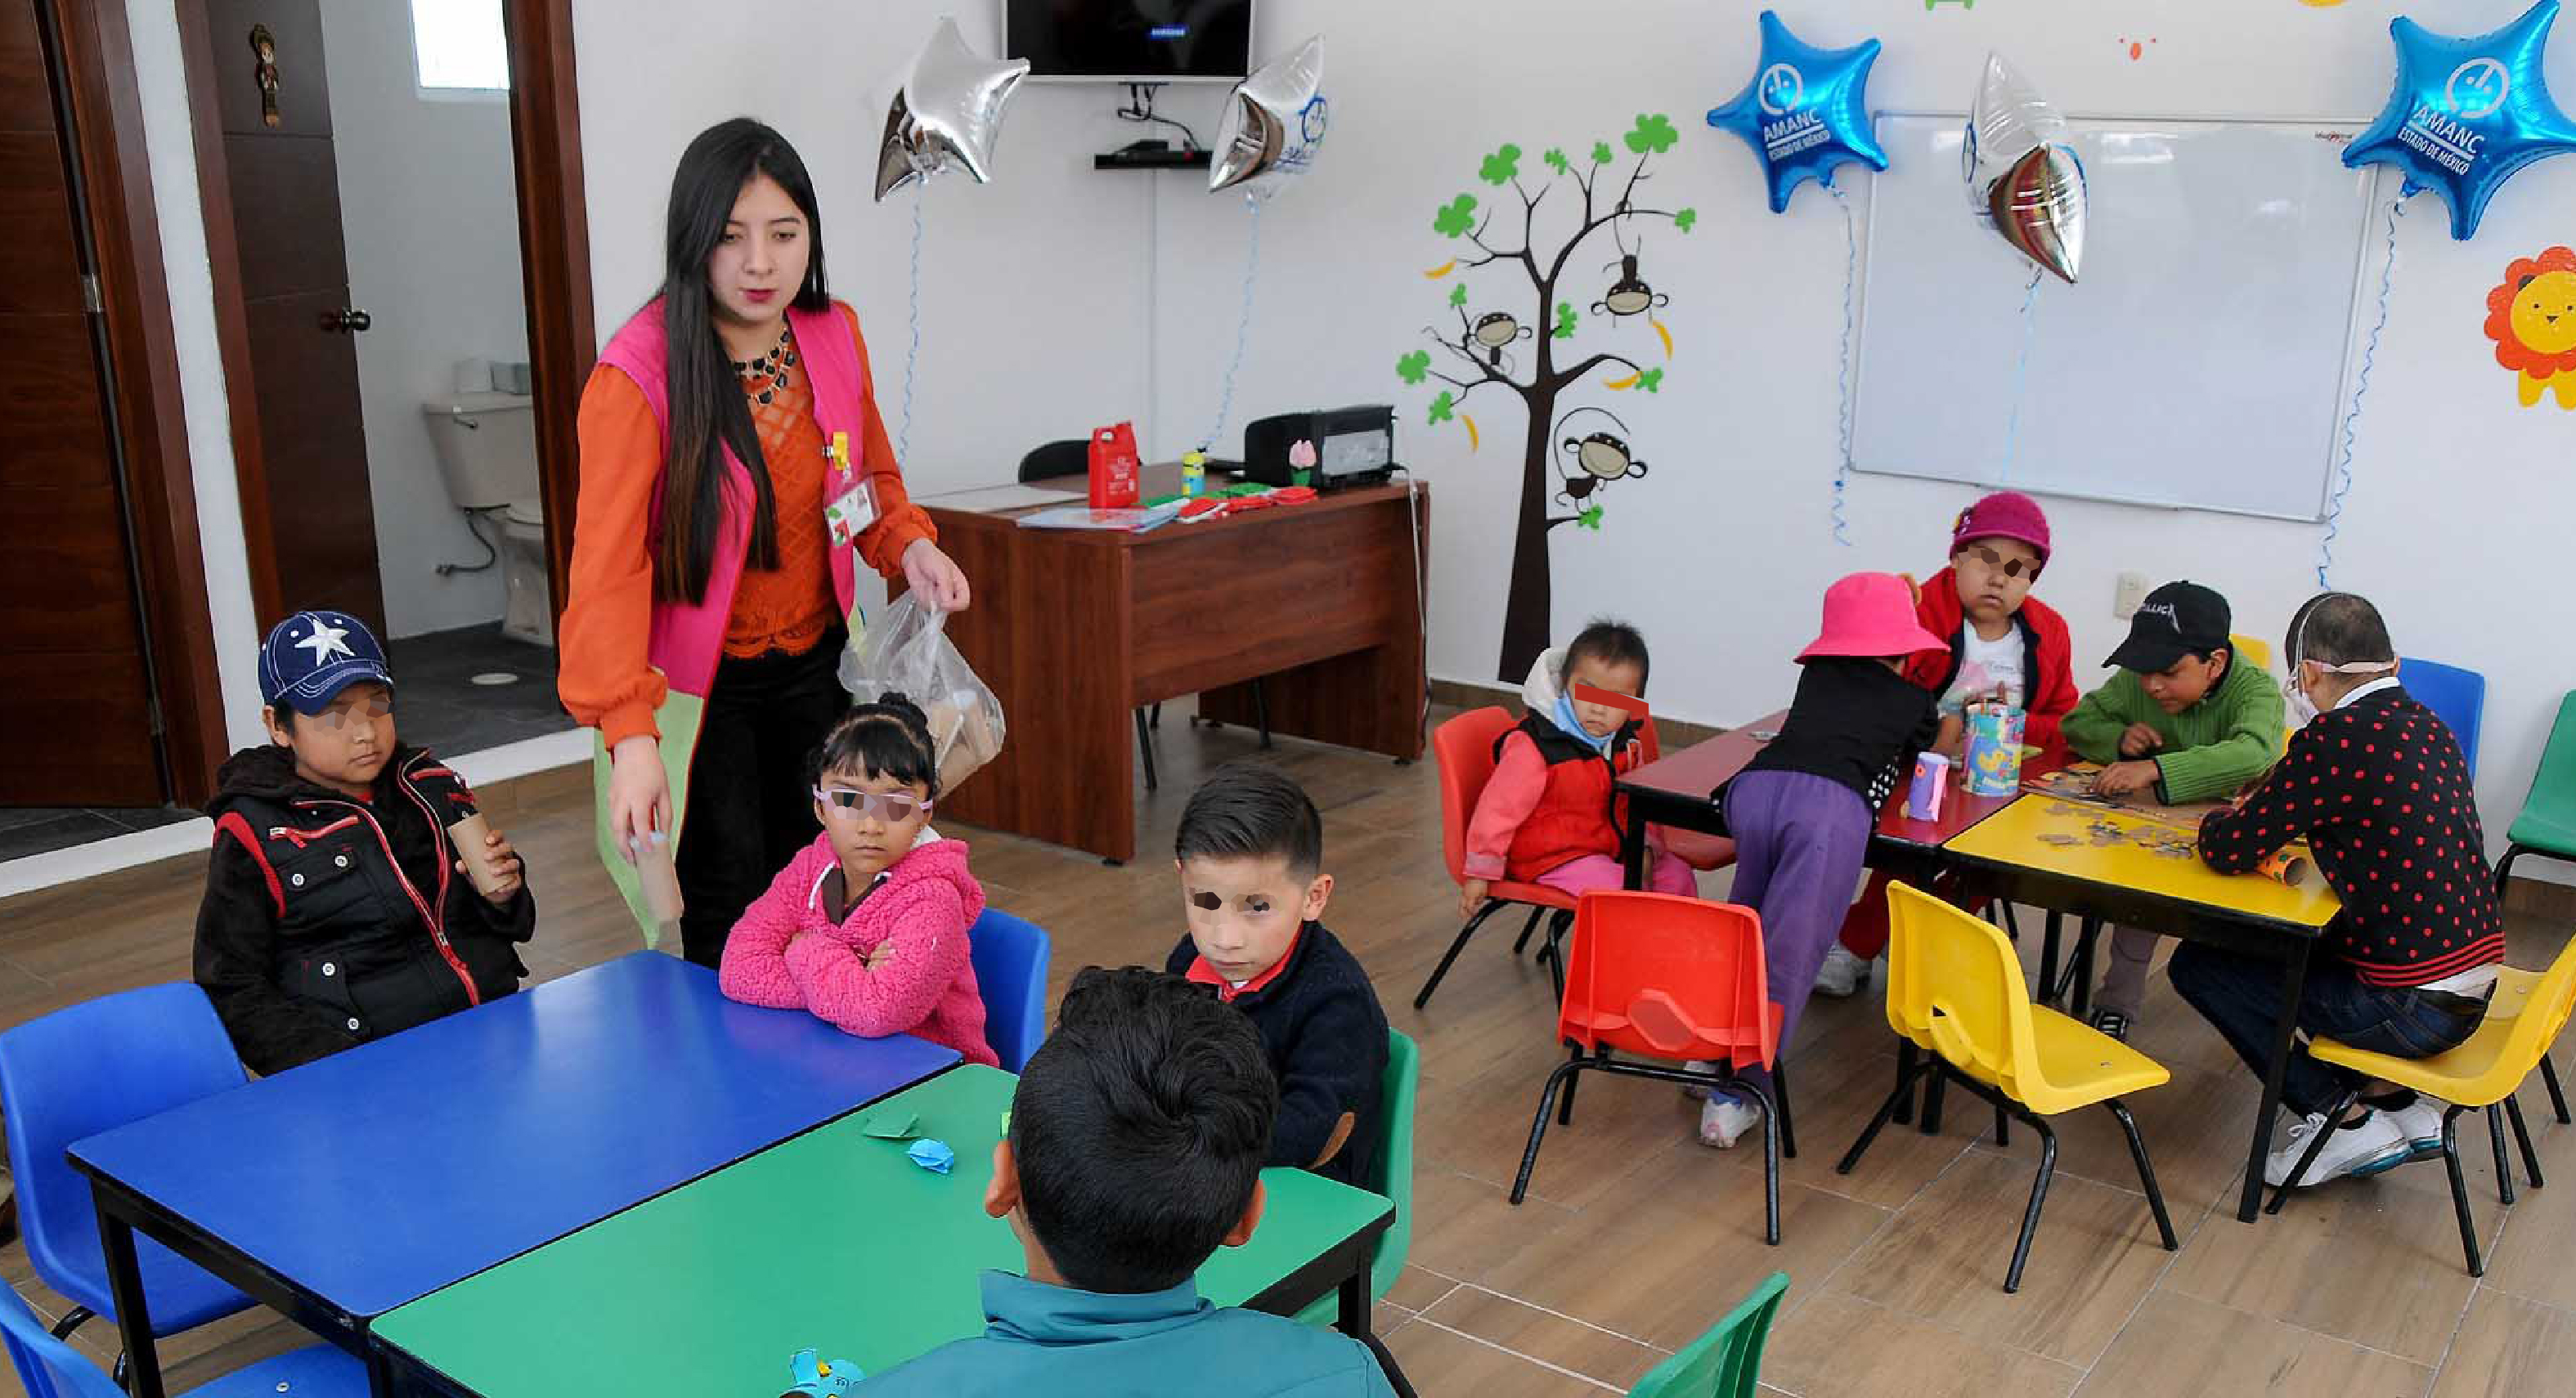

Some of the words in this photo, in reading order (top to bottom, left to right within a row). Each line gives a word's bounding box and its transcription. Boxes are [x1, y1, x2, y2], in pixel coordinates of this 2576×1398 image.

[1764, 107, 1821, 143] AMANC
[2398, 126, 2429, 152] ESTADO
[2426, 142, 2440, 159] DE
[2412, 105, 2484, 154] AMANC
